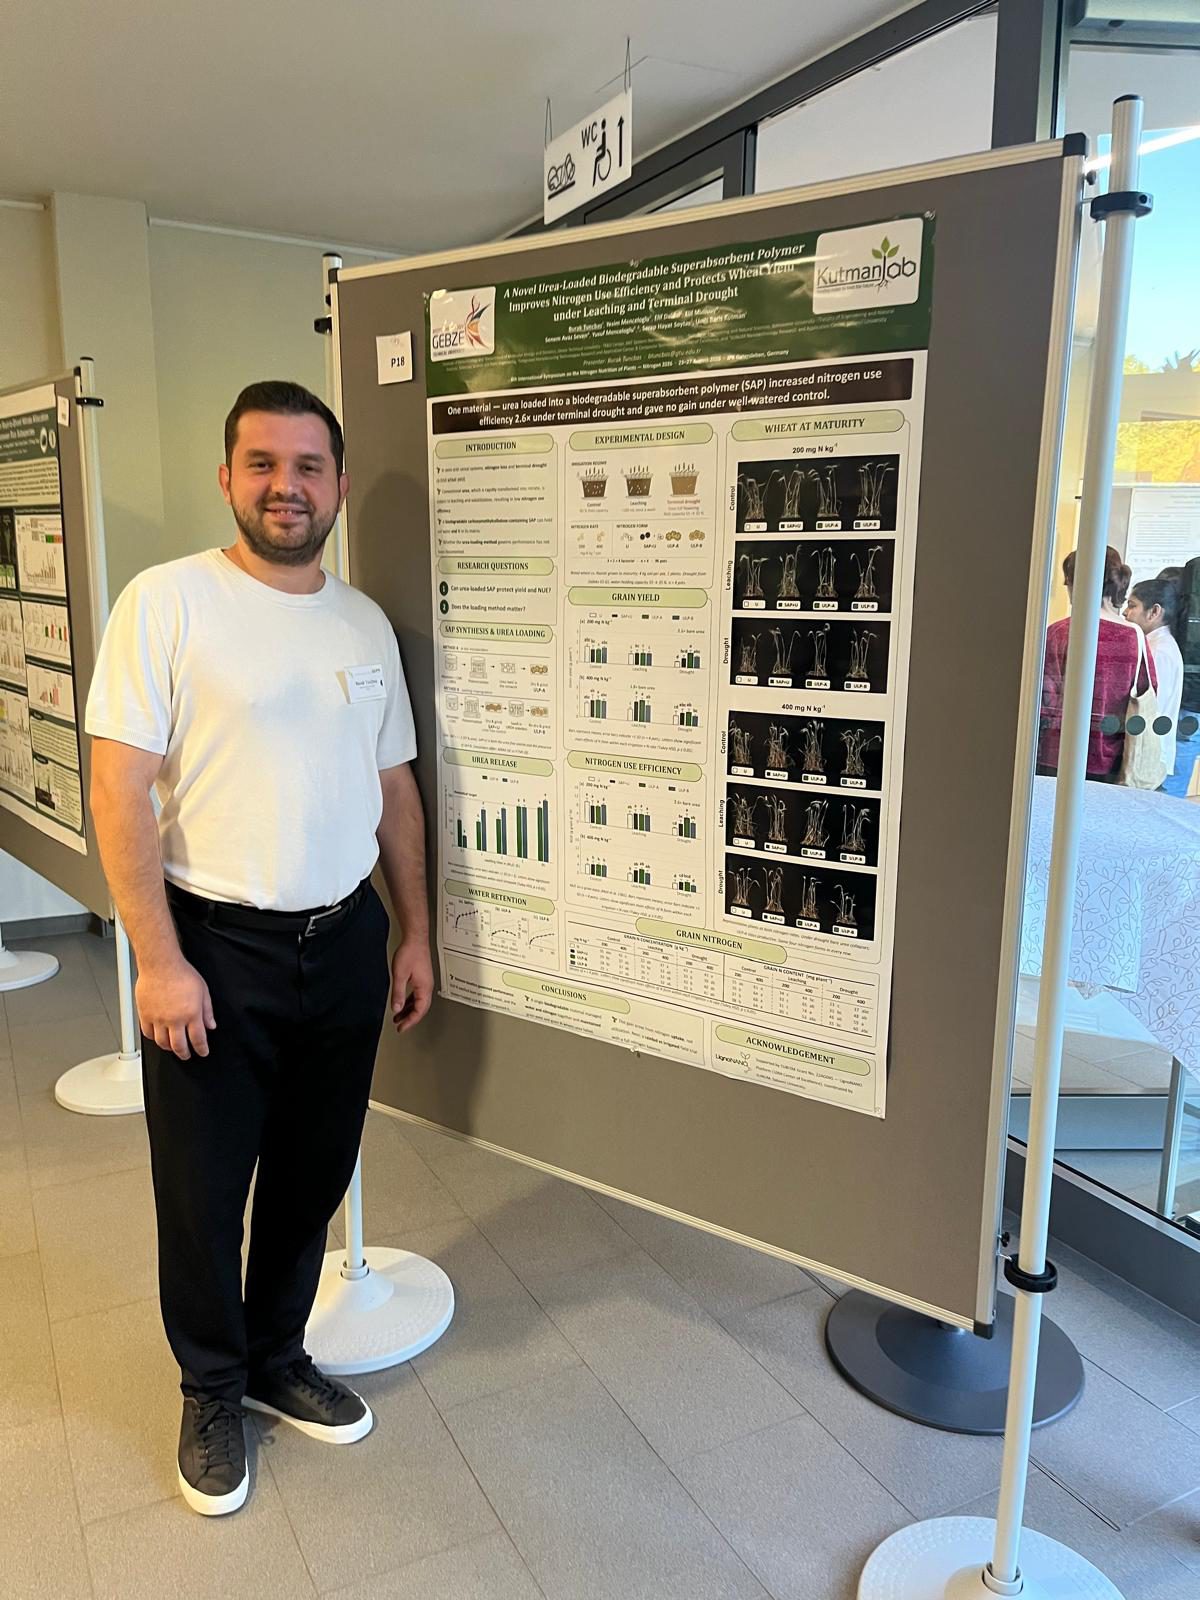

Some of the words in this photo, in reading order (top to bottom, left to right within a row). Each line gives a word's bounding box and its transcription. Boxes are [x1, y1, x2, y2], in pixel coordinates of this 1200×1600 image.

[581, 122, 597, 149] WC
[504, 289, 511, 298] A
[512, 286, 536, 297] Novel
[538, 275, 596, 293] Urea-Loaded
[599, 265, 668, 284] Biodegradable
[671, 250, 754, 274] Superabsorbent
[757, 243, 805, 262] Polymer
[509, 299, 550, 314] Improves
[552, 292, 592, 307] Nitrogen
[595, 290, 611, 300] Use
[614, 282, 660, 298] Efficiency
[662, 280, 681, 291] and
[684, 274, 726, 290] Protects
[729, 264, 765, 282] Wheat
[554, 310, 581, 322] under
[584, 302, 626, 318] Leaching
[628, 302, 645, 312] and
[648, 292, 693, 309] Terminal
[695, 287, 738, 308] Drought
[432, 331, 465, 349] GEBZE
[391, 356, 405, 368] P18
[448, 405, 461, 416] One
[463, 402, 491, 415] material
[502, 400, 518, 410] urea
[521, 397, 546, 410] loaded
[548, 396, 563, 407] into
[566, 397, 570, 405] a
[573, 390, 630, 406] biodegradable
[633, 384, 698, 402] superabsorbent
[701, 381, 739, 396] polymer
[741, 380, 767, 393] (SAP)
[769, 374, 814, 388] increased
[818, 372, 860, 385] nitrogen
[864, 370, 882, 380] use
[479, 415, 514, 427] efficiency
[533, 410, 555, 422] under
[558, 408, 590, 420] terminal
[592, 405, 625, 418] drought
[627, 404, 642, 415] and
[644, 403, 664, 416] gave
[666, 403, 676, 412] no
[678, 399, 697, 412] gain
[699, 398, 726, 410] under
[729, 394, 789, 407] well-watered
[792, 389, 830, 402] control.
[765, 423, 797, 434] WHEAT
[799, 422, 811, 431] AT
[814, 419, 865, 430] MATURITY
[595, 433, 654, 444] EXPERIMENTAL
[656, 431, 685, 440] DESIGN
[465, 442, 516, 452] INTRODUCTION
[792, 446, 804, 454] 200
[806, 446, 817, 454] mg
[458, 562, 489, 570] RESEARCH
[612, 593, 635, 601] GRAIN
[638, 593, 660, 602] YIELD
[782, 703, 793, 711] 400
[472, 756, 488, 764] UREA
[490, 758, 517, 768] RELEASE
[585, 757, 622, 769] NITROGEN
[623, 762, 637, 770] USE
[639, 763, 682, 775] EFFICIENCY
[468, 888, 490, 898] WATER
[491, 892, 527, 906] RETENTION
[676, 930, 701, 941] GRAIN
[702, 934, 743, 950] NITROGEN
[541, 984, 587, 1001] CONCLUSIONS
[746, 1036, 835, 1065] ACKNOWLEDGEMENT
